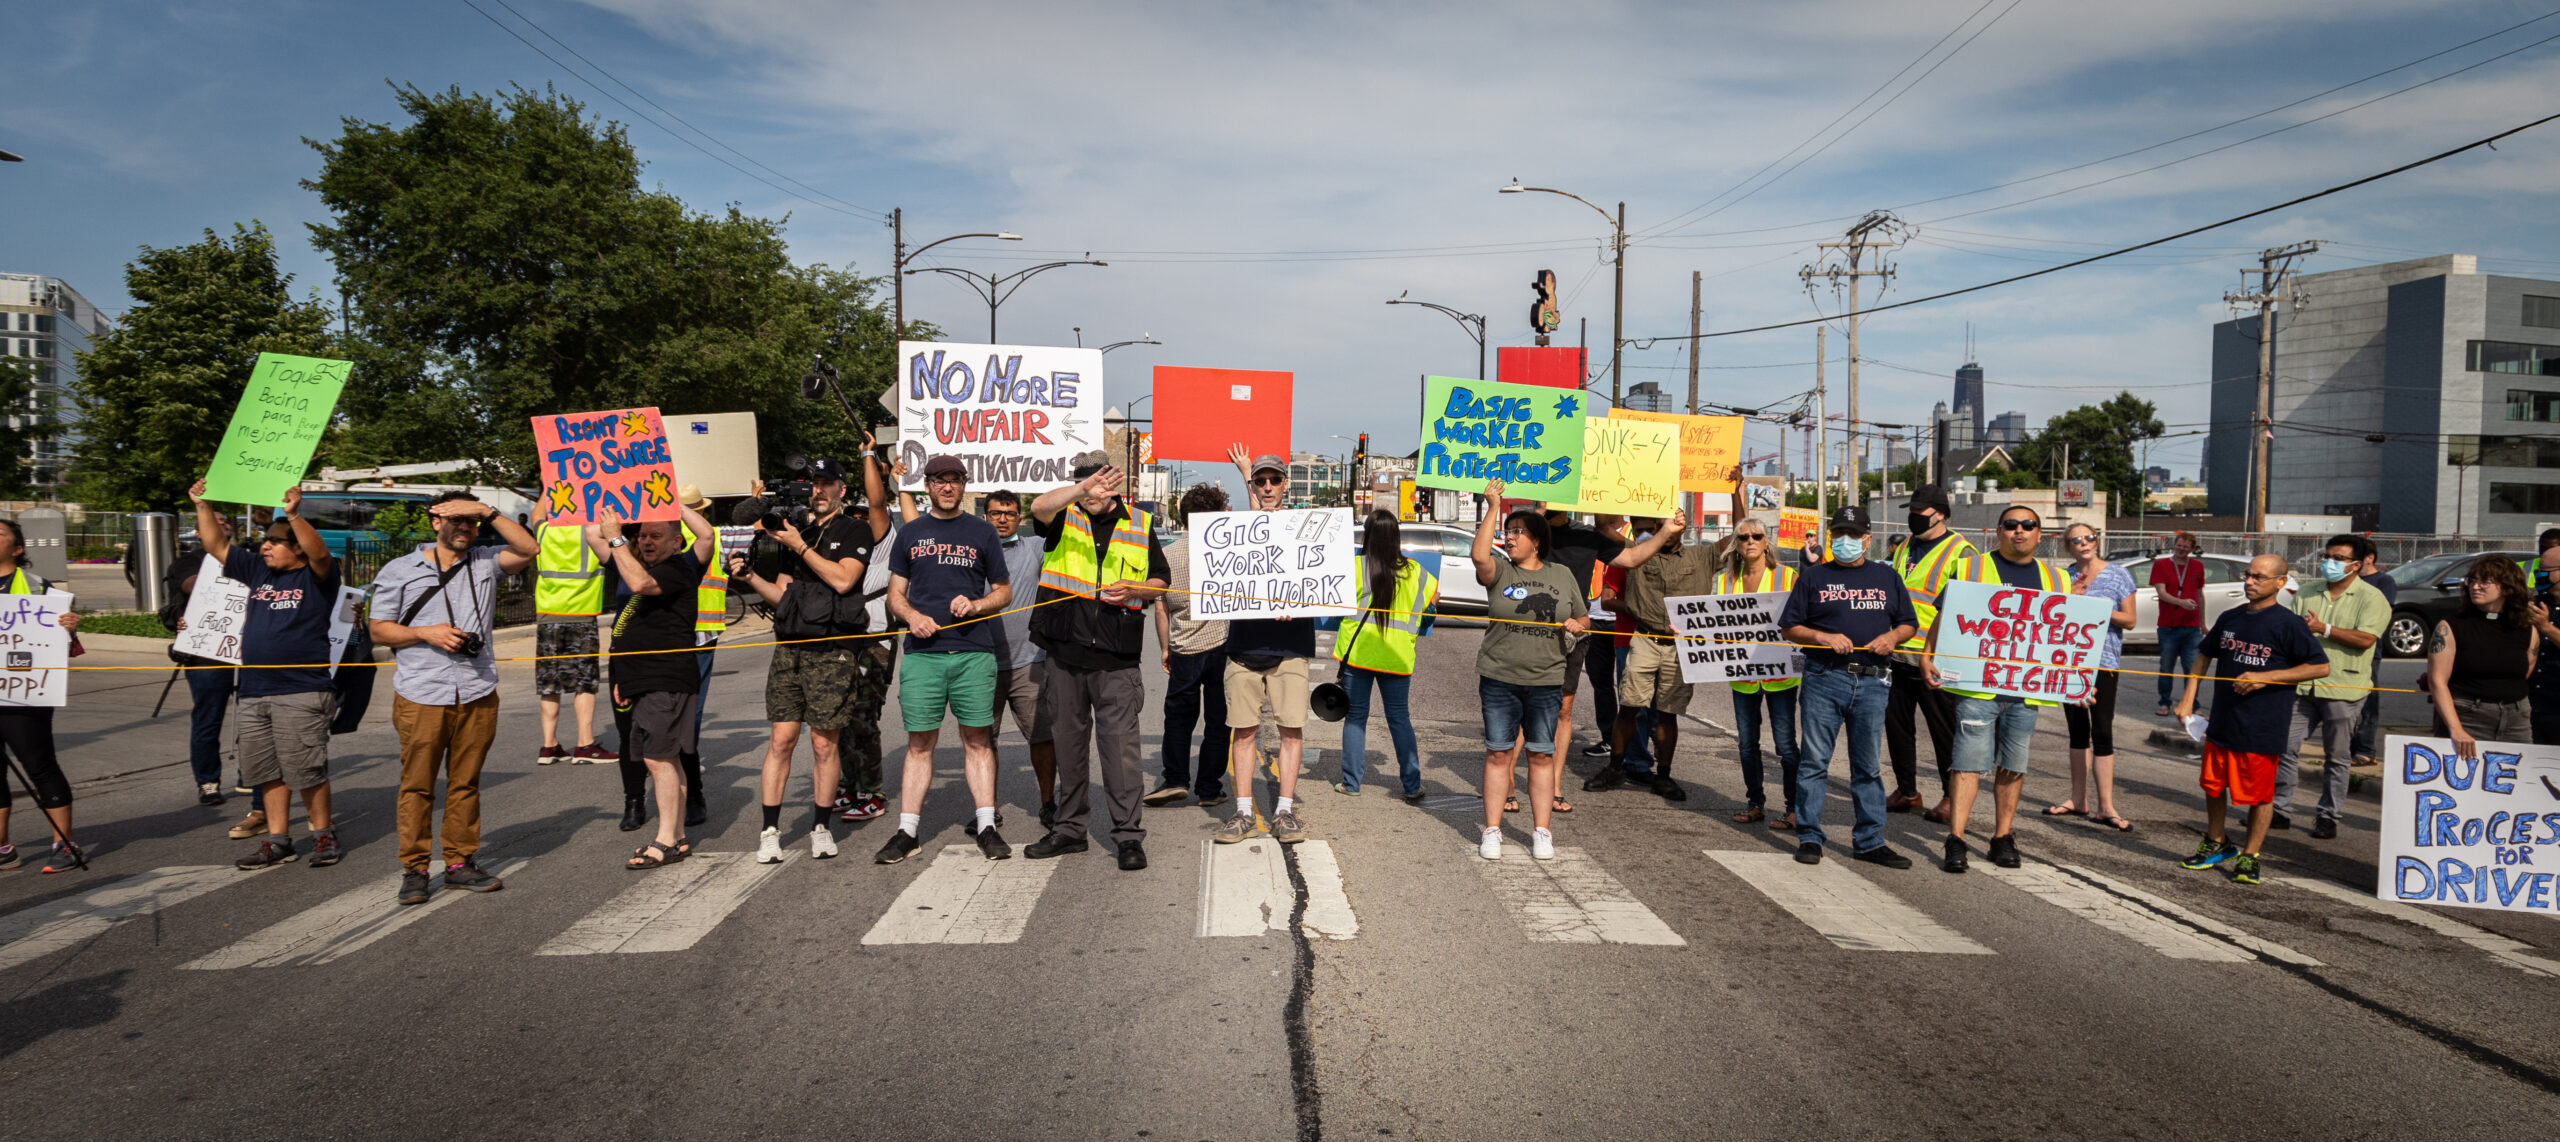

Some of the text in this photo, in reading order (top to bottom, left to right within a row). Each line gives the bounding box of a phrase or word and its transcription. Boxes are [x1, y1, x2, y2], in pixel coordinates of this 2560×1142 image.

[269, 361, 322, 389] Toque
[910, 350, 1081, 408] NO MORE
[259, 387, 308, 412] Bocina
[1444, 386, 1533, 421] BASIC
[261, 410, 292, 427] para
[555, 415, 618, 445] RIGHT
[934, 408, 1054, 445] UNFAIR
[237, 425, 288, 443] mejor
[1433, 416, 1545, 450] WORKER
[236, 451, 304, 478] Seguridad
[548, 436, 672, 480] TO SURGE
[902, 440, 1077, 486] DTIVATION
[1422, 441, 1572, 484] PROTECTIONS
[582, 481, 642, 522] PAY
[1581, 487, 1609, 501] iver
[918, 538, 935, 546] THE
[1204, 514, 1270, 549] GIG
[910, 543, 977, 560] PEOPLE'S
[937, 554, 976, 568] LOBBY
[1204, 544, 1325, 578] WORK IS
[1200, 574, 1346, 614] REAL WORK
[1548, 584, 1560, 596] TO
[1819, 588, 1887, 603] PEOPLE'S
[0, 598, 56, 631] yft
[268, 600, 300, 610] OBBY
[1677, 597, 1760, 616] ASK YOUR
[1850, 600, 1886, 610] LOBBY
[1988, 588, 2067, 626] GIG
[198, 611, 233, 634] FOR
[1504, 623, 1556, 640] THE PEOPLE
[1686, 612, 1773, 630] ALDERMAN
[1683, 634, 1706, 647] TO
[1979, 638, 2087, 668] BILL OF
[2220, 637, 2272, 658] EOPLE'S
[1688, 647, 1749, 664] DRIVER
[2233, 651, 2268, 667] LOBBY
[1725, 662, 1786, 678] SAFETY
[1982, 662, 2094, 700] RIGHTS
[2403, 742, 2523, 795] DUE
[2415, 789, 2560, 847] PROCES
[2495, 845, 2535, 866] FOR
[2396, 856, 2560, 911] DRIVE
